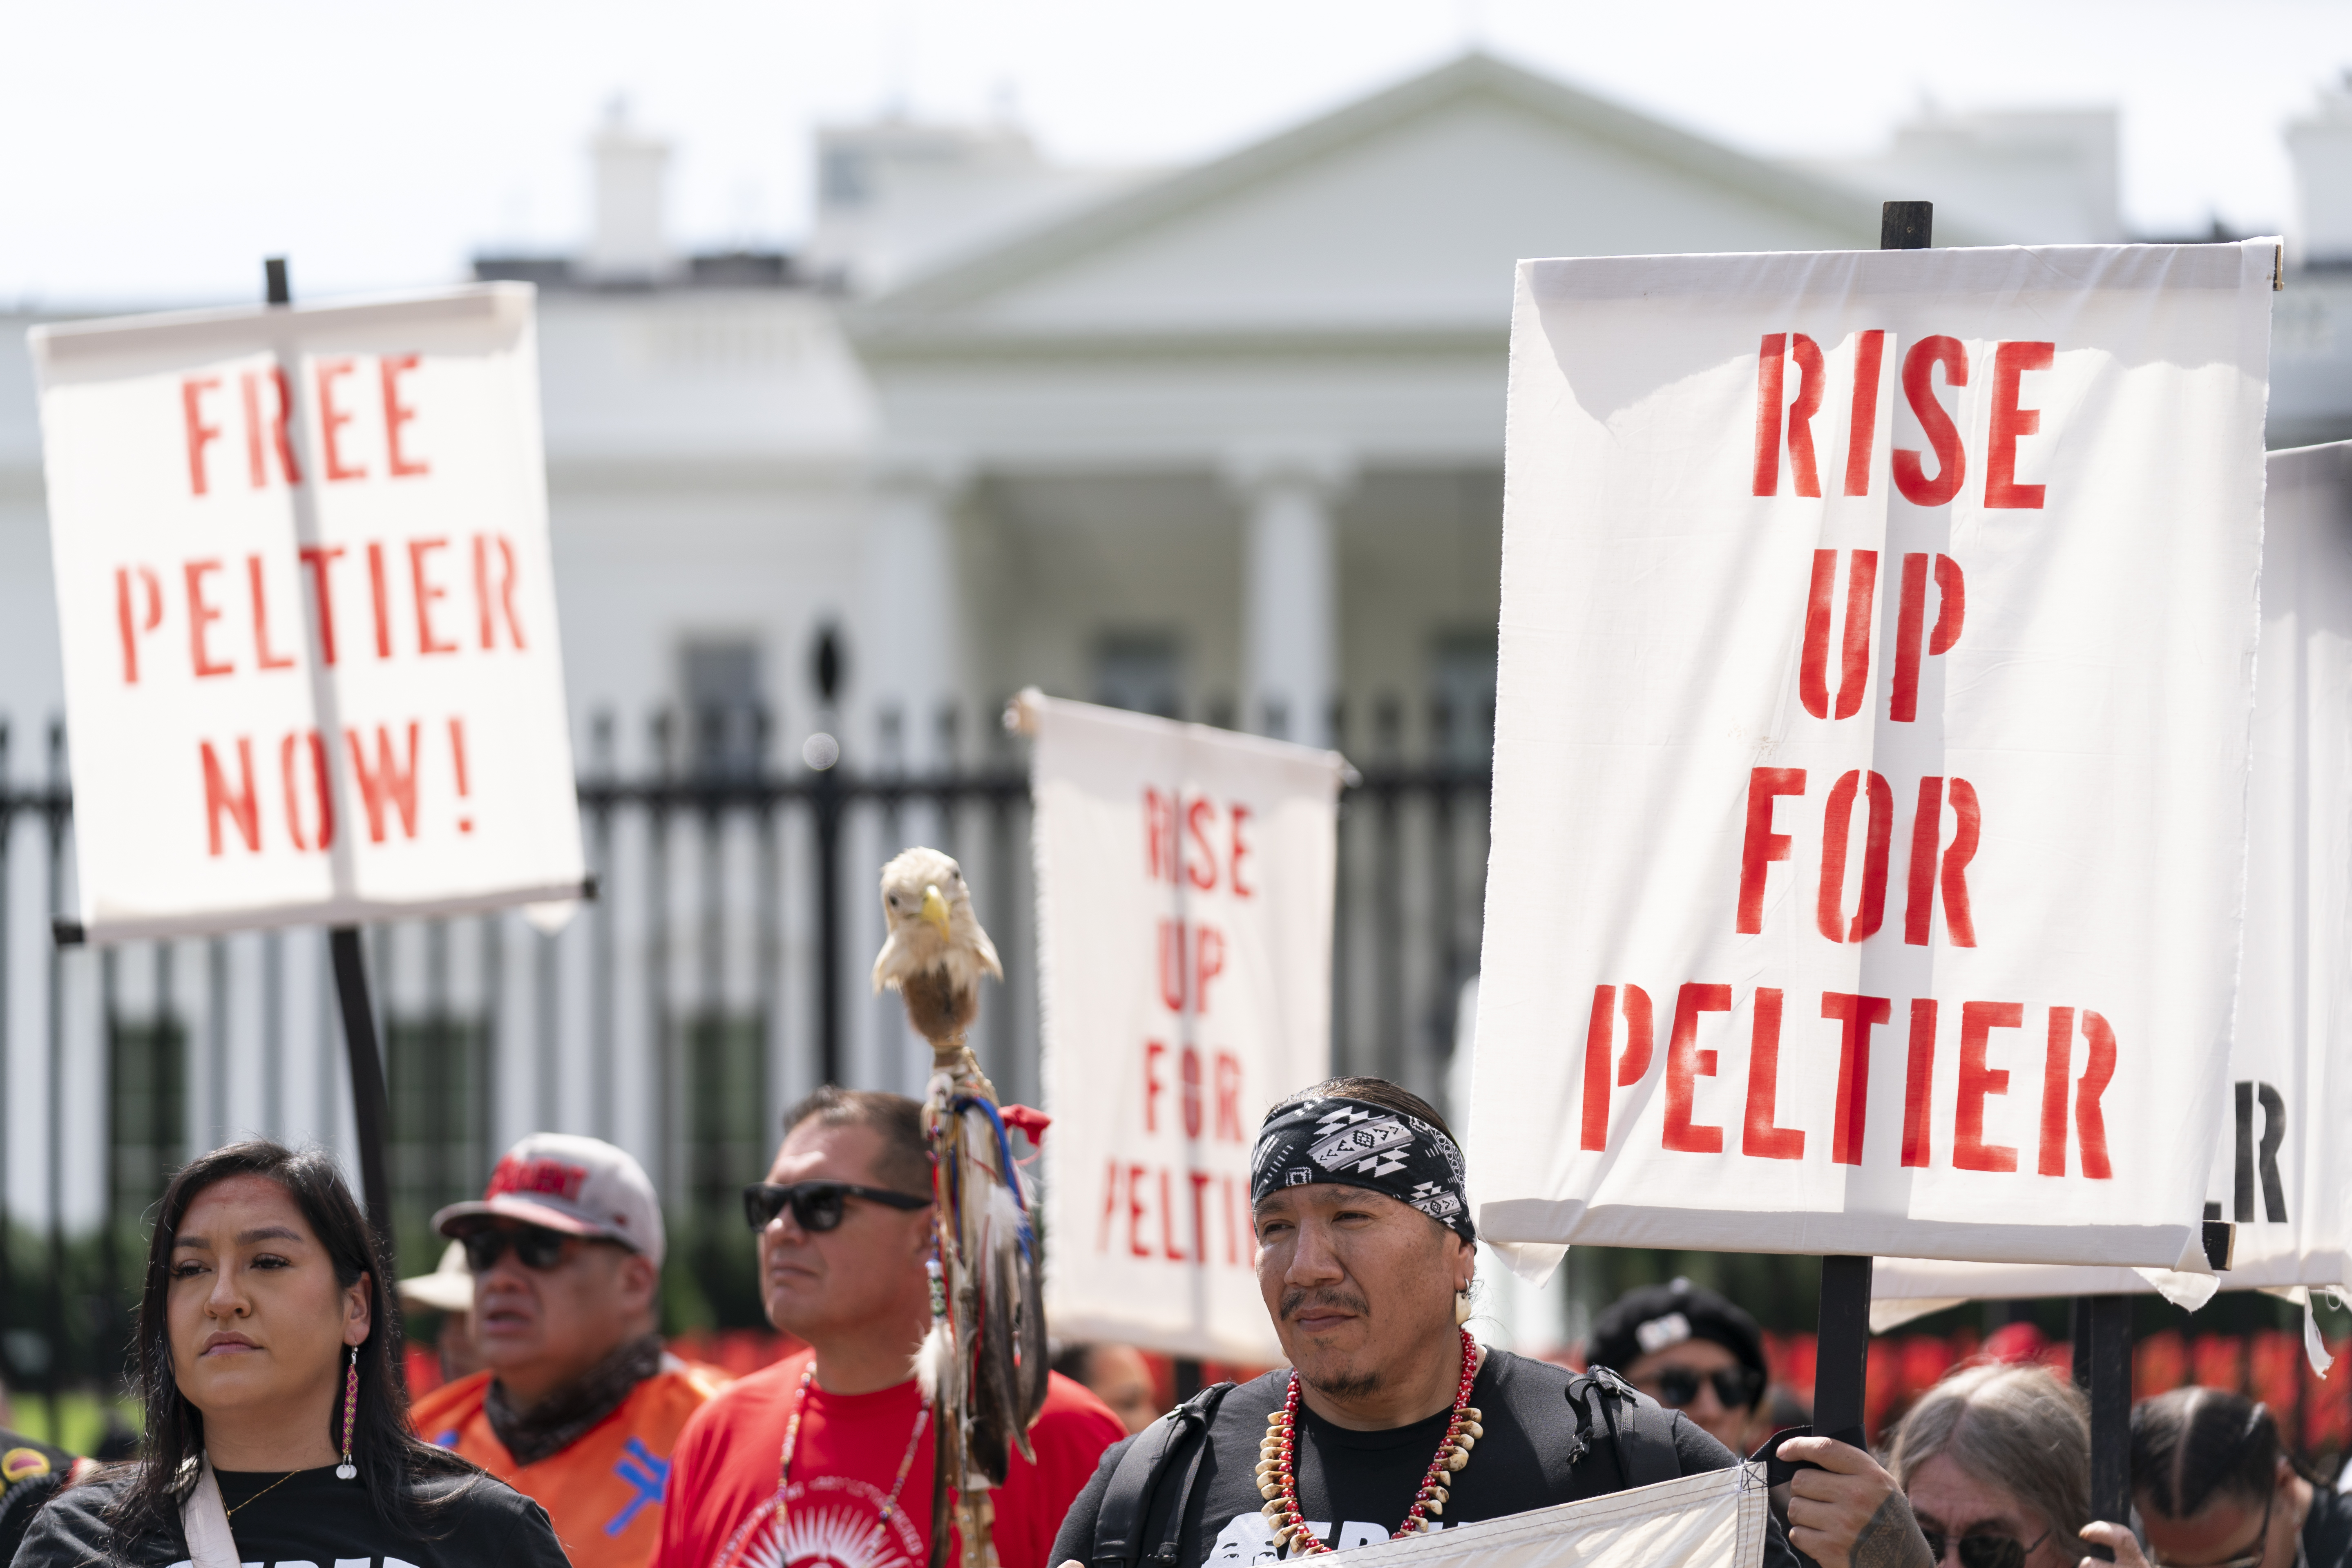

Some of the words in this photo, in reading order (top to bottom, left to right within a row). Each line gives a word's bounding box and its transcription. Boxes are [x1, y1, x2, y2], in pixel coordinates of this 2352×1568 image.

[182, 354, 429, 497] FREE
[1752, 329, 2055, 509] RISE
[116, 534, 526, 685] PELTIER
[1799, 548, 1966, 723] UP
[199, 718, 474, 857] NOW!
[1144, 786, 1253, 900] RISE
[1736, 766, 1981, 948] FOR
[1158, 920, 1225, 1016] UP
[1144, 1038, 1244, 1144] FOR
[1580, 981, 2117, 1181] PELTIER
[1099, 1159, 1256, 1271] PELTI
